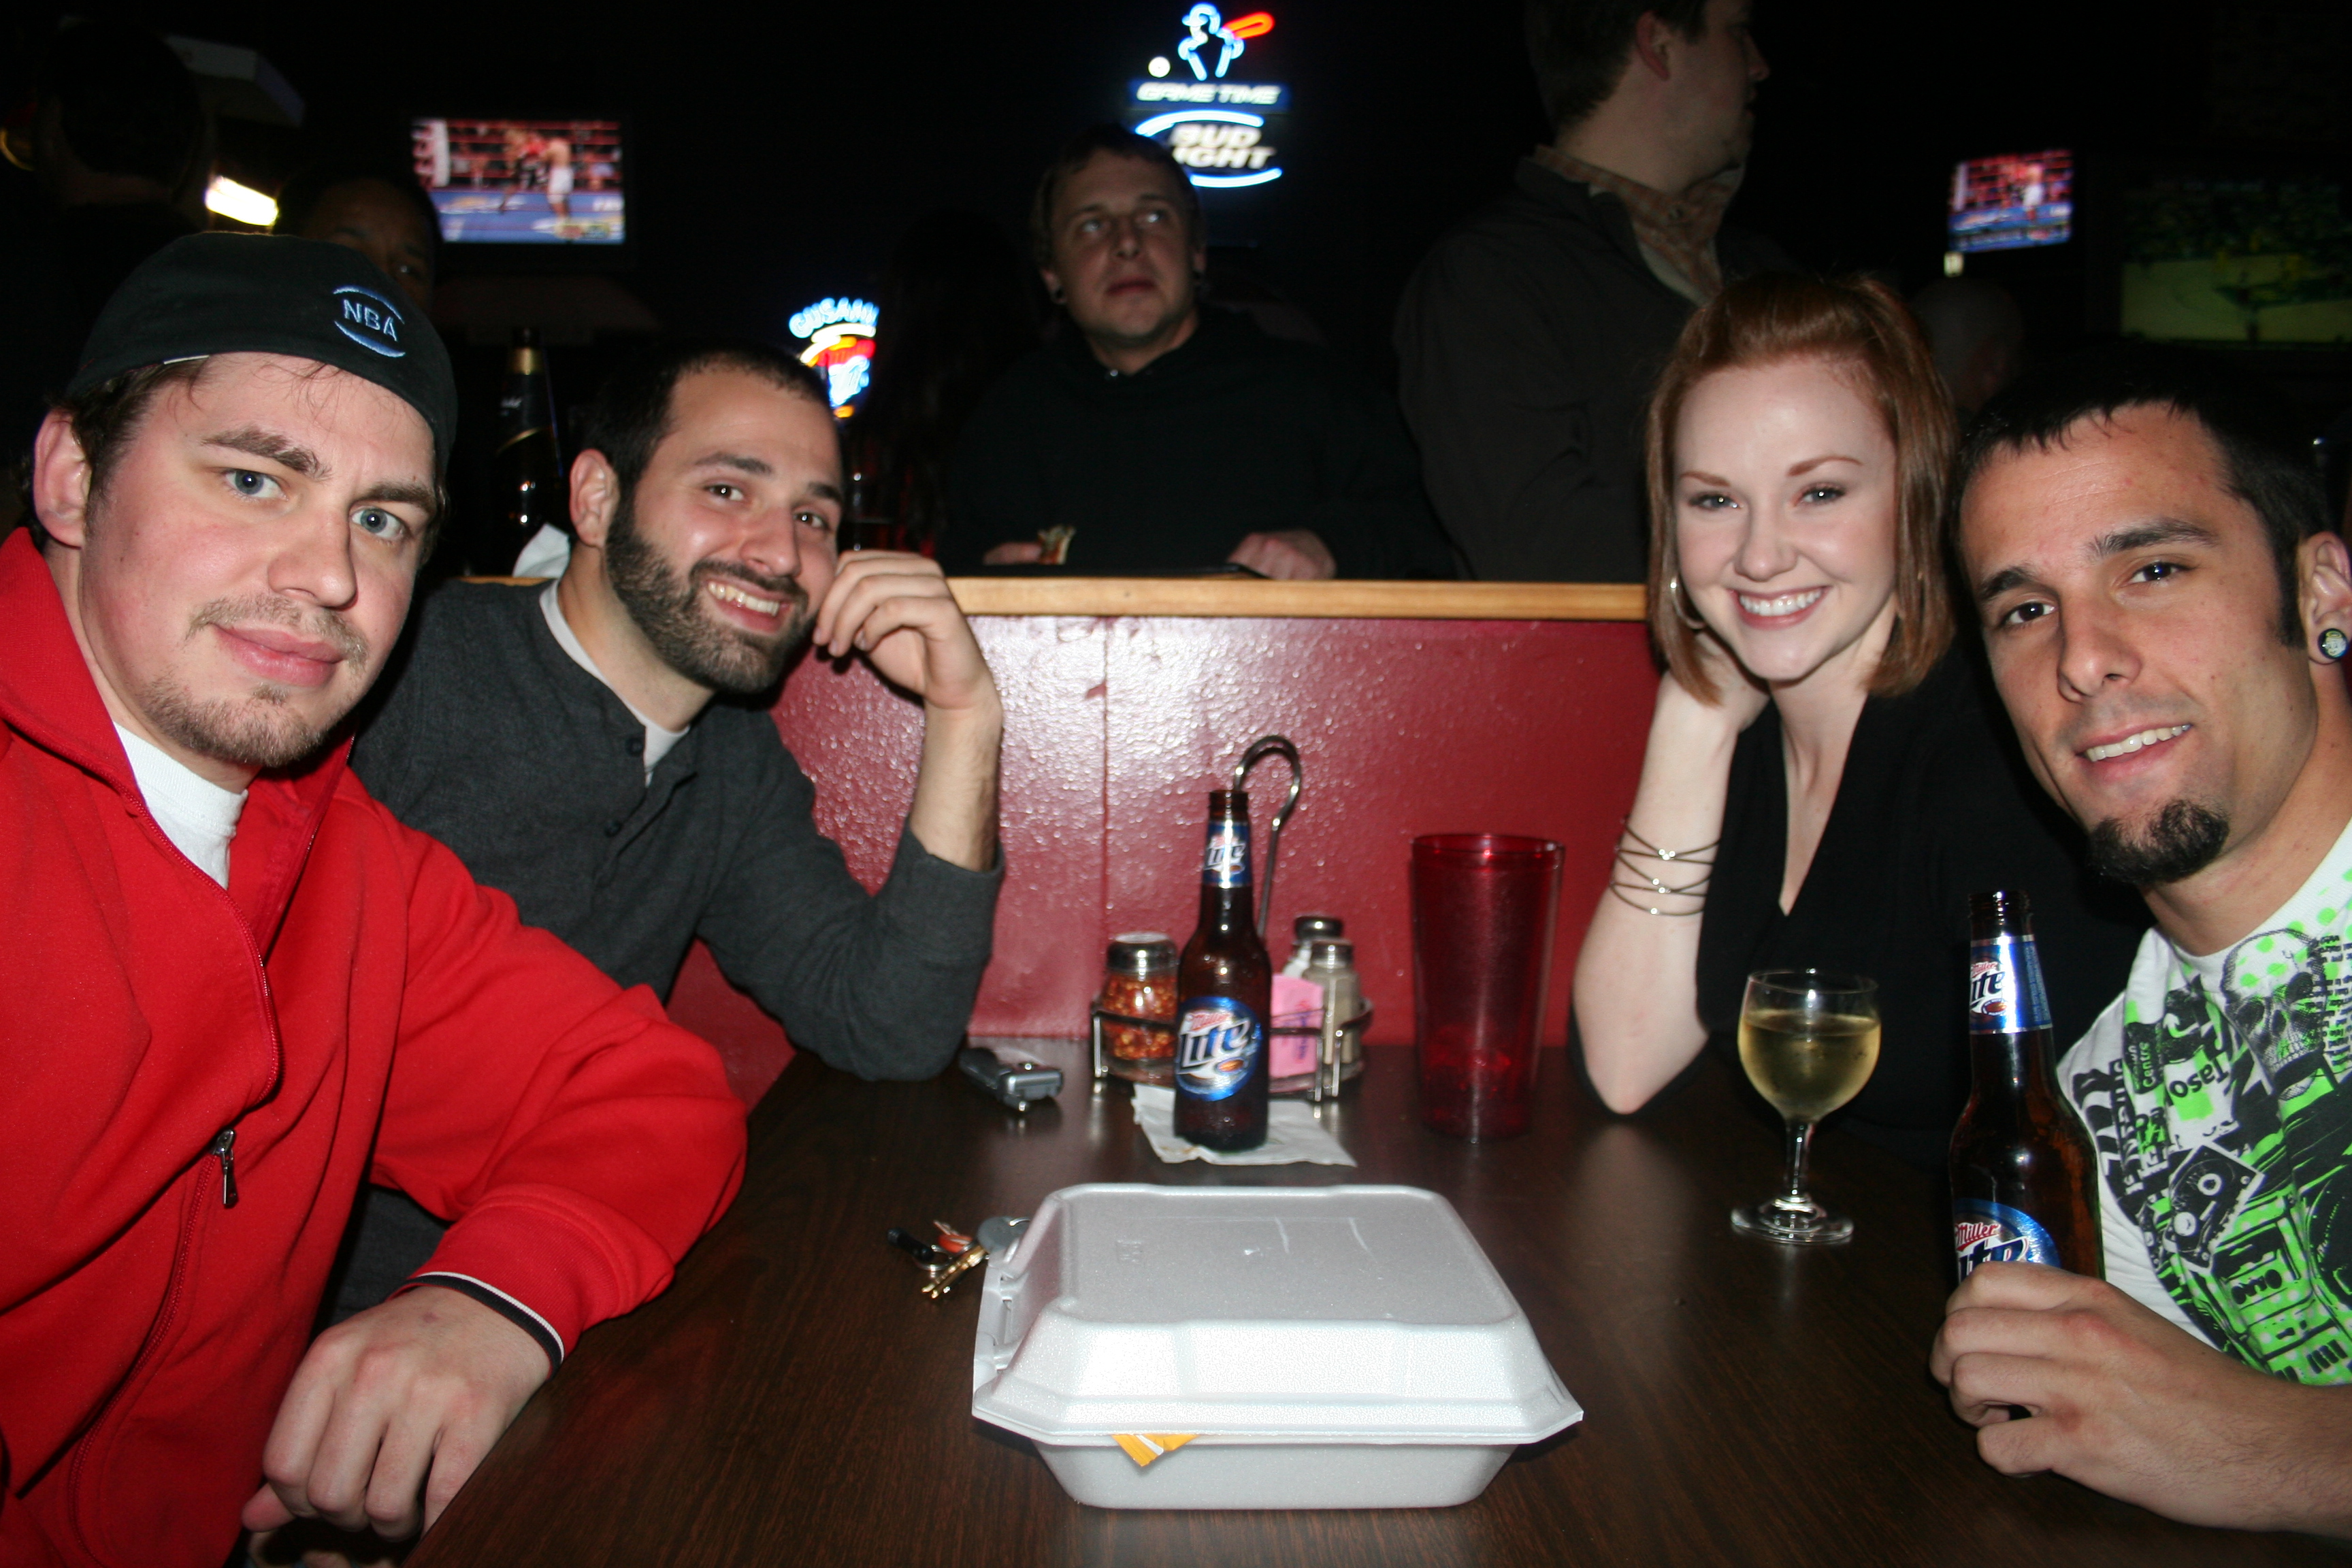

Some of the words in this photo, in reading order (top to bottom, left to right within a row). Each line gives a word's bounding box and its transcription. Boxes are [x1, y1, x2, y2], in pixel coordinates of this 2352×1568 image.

[1137, 82, 1218, 103] GAME
[1216, 84, 1281, 105] TIME
[1171, 124, 1261, 148] BUD
[1173, 146, 1275, 169] IGHT
[343, 299, 397, 342] NBA
[1204, 843, 1246, 870] Lie
[1970, 972, 2006, 1007] ite
[1177, 1019, 1250, 1074] Lite
[1955, 1222, 2001, 1246] Miller
[1957, 1236, 2027, 1282] ite
